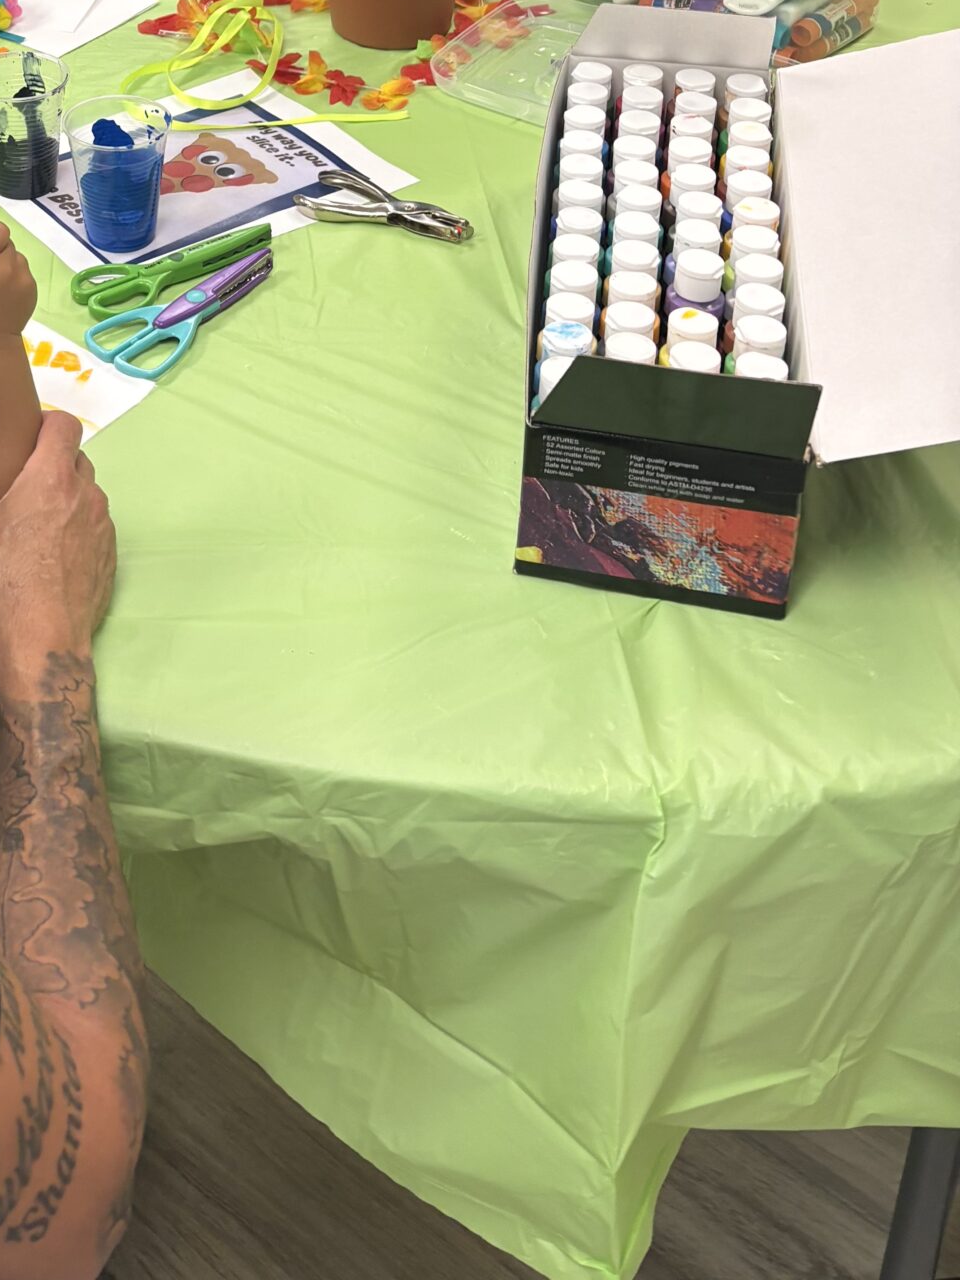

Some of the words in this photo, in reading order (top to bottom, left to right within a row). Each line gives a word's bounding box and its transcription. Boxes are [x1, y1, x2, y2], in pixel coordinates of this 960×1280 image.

[246, 135, 280, 154] slice
[272, 132, 303, 151] way
[293, 149, 329, 168] you
[542, 434, 580, 445] FEATURES
[546, 448, 582, 458] Semi-matte
[555, 443, 584, 452] Assorted
[584, 447, 606, 455] Colors
[545, 455, 572, 464] Spreads
[630, 454, 645, 463] High
[646, 456, 668, 466] quality
[669, 460, 699, 470] pigments
[645, 463, 665, 473] drying
[628, 474, 660, 485] Conforms
